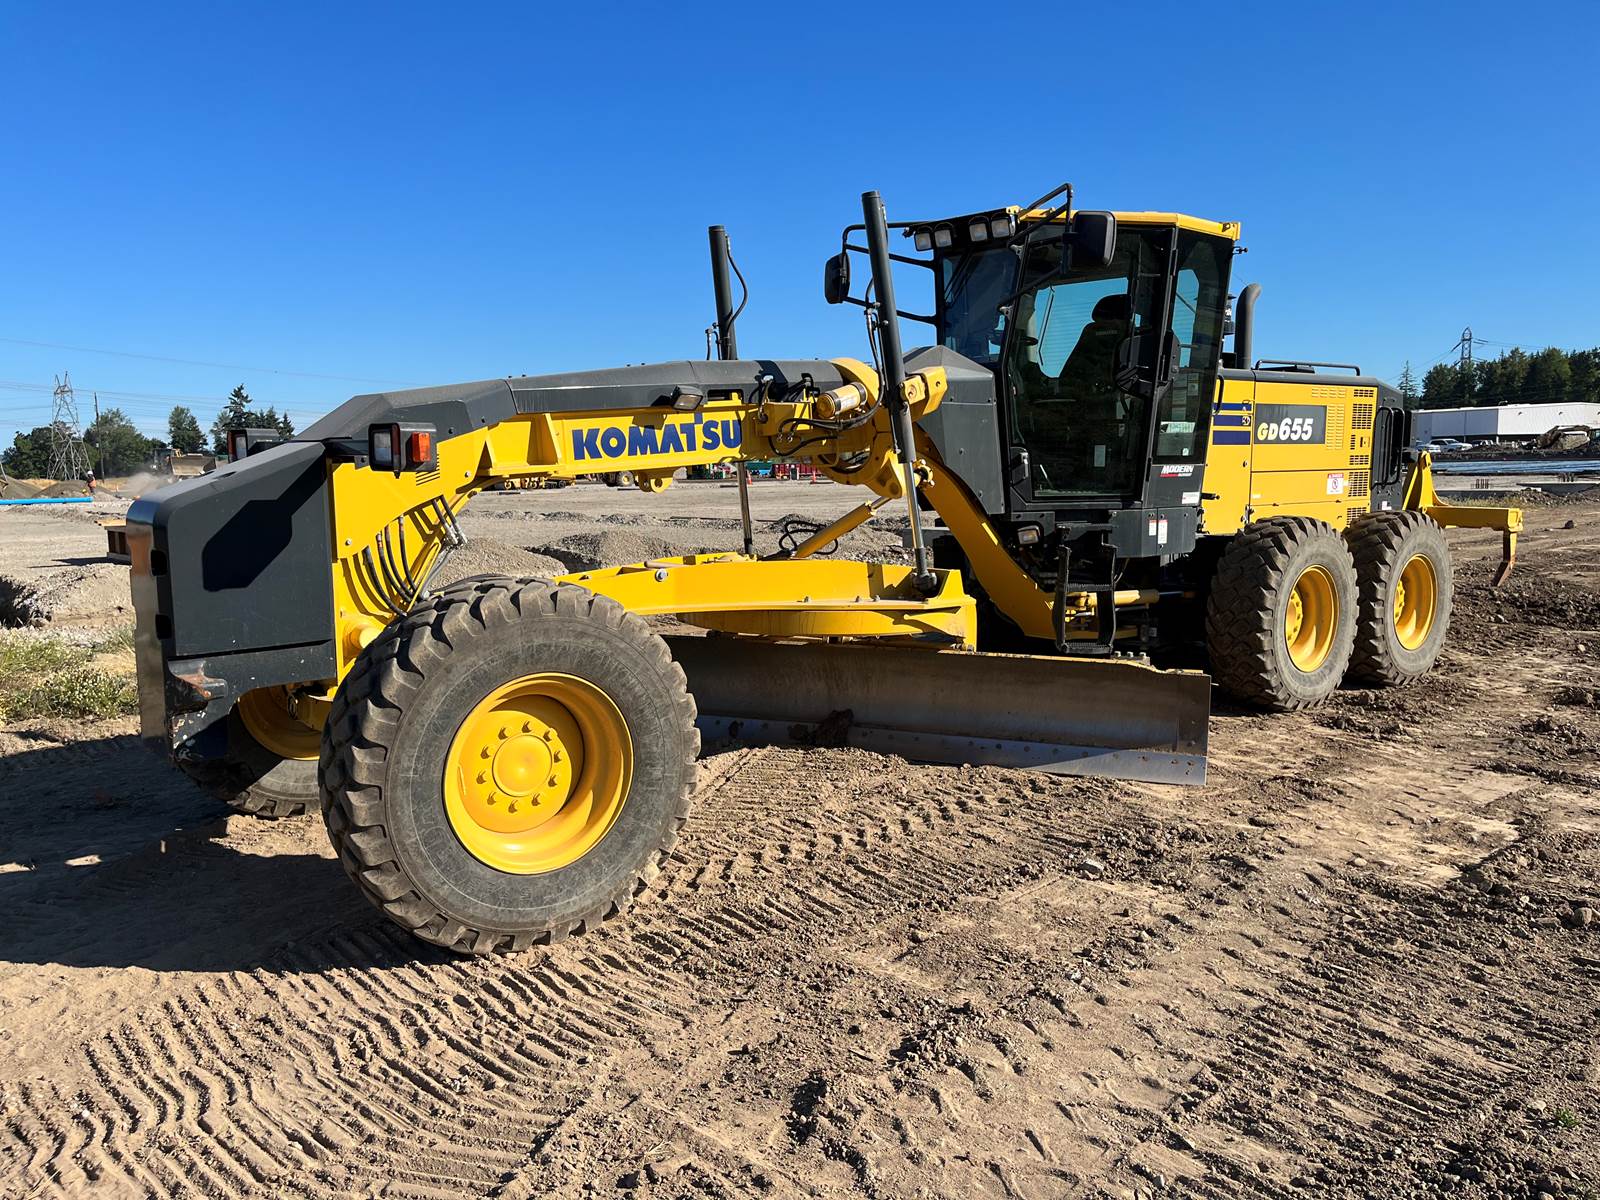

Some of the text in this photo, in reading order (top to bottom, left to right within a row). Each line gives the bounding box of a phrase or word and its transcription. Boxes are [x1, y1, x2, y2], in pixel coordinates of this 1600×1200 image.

[572, 413, 742, 460] KOMATSU
[1257, 417, 1314, 441] GD655
[1161, 464, 1195, 475] MODERN
